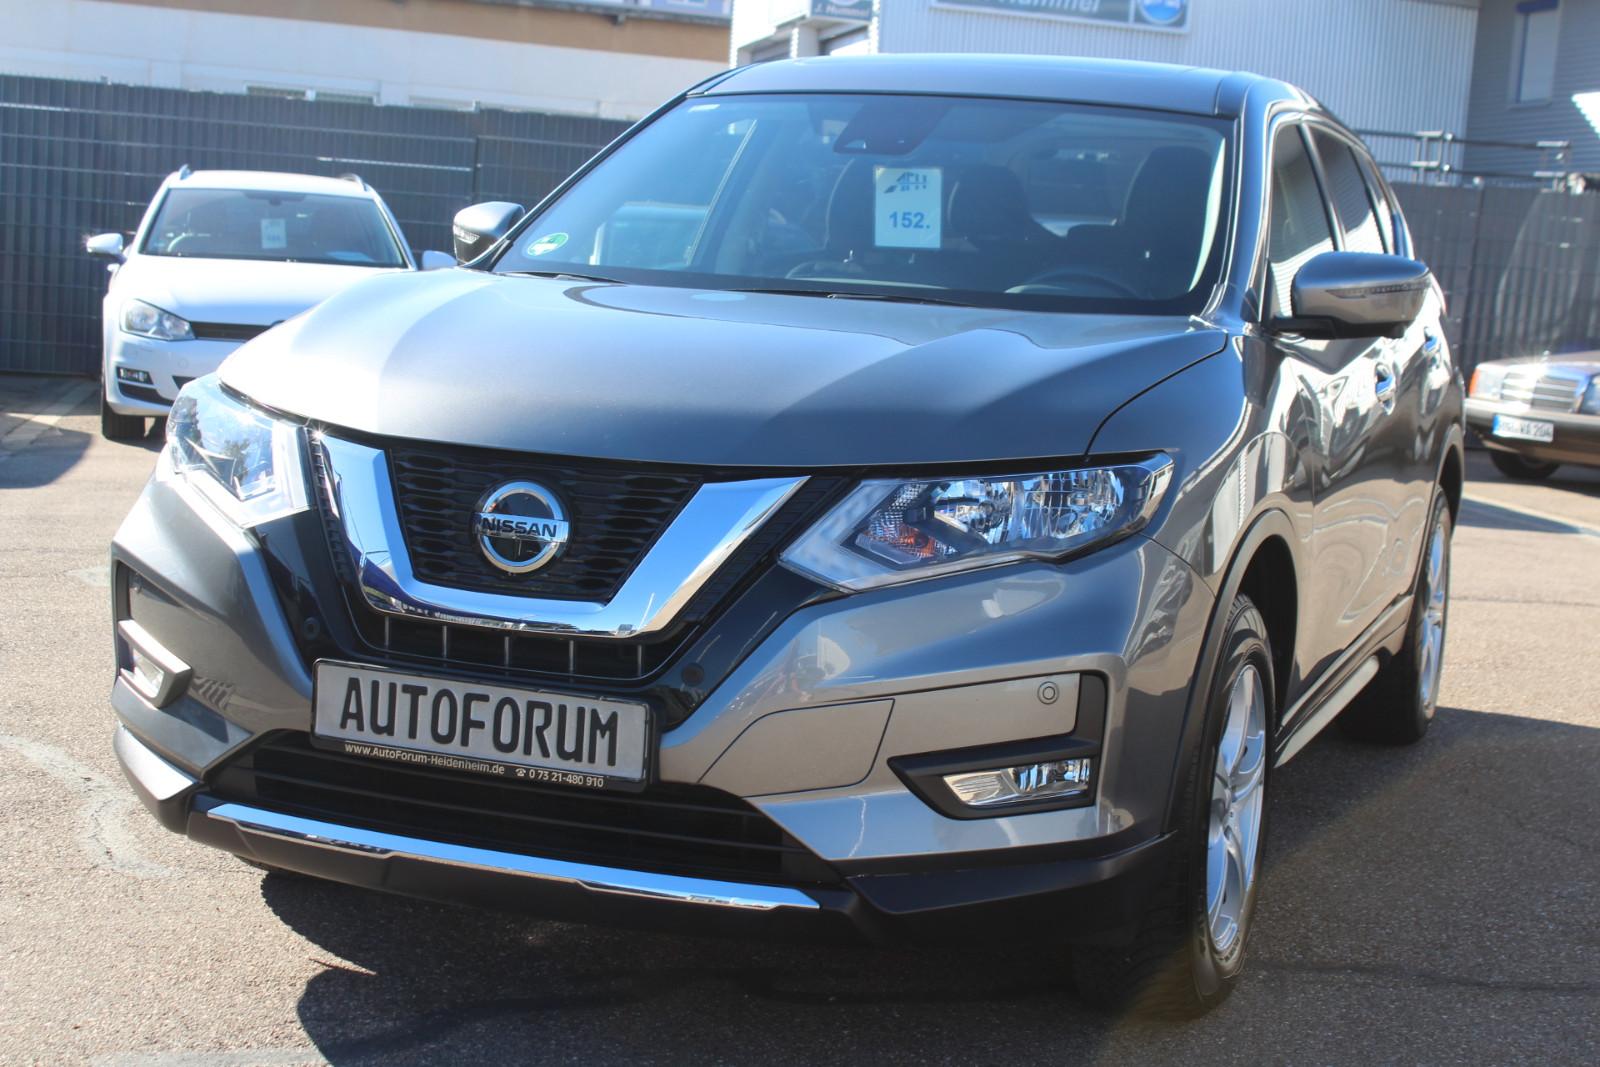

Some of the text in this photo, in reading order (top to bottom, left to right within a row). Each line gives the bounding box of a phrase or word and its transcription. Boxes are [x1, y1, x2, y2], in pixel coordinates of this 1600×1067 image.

[999, 0, 1100, 13] ummel
[481, 517, 557, 537] NISSAN
[340, 677, 618, 767] AUTOFORUM
[344, 744, 505, 775] www.AutoForum-Heidenheim.de
